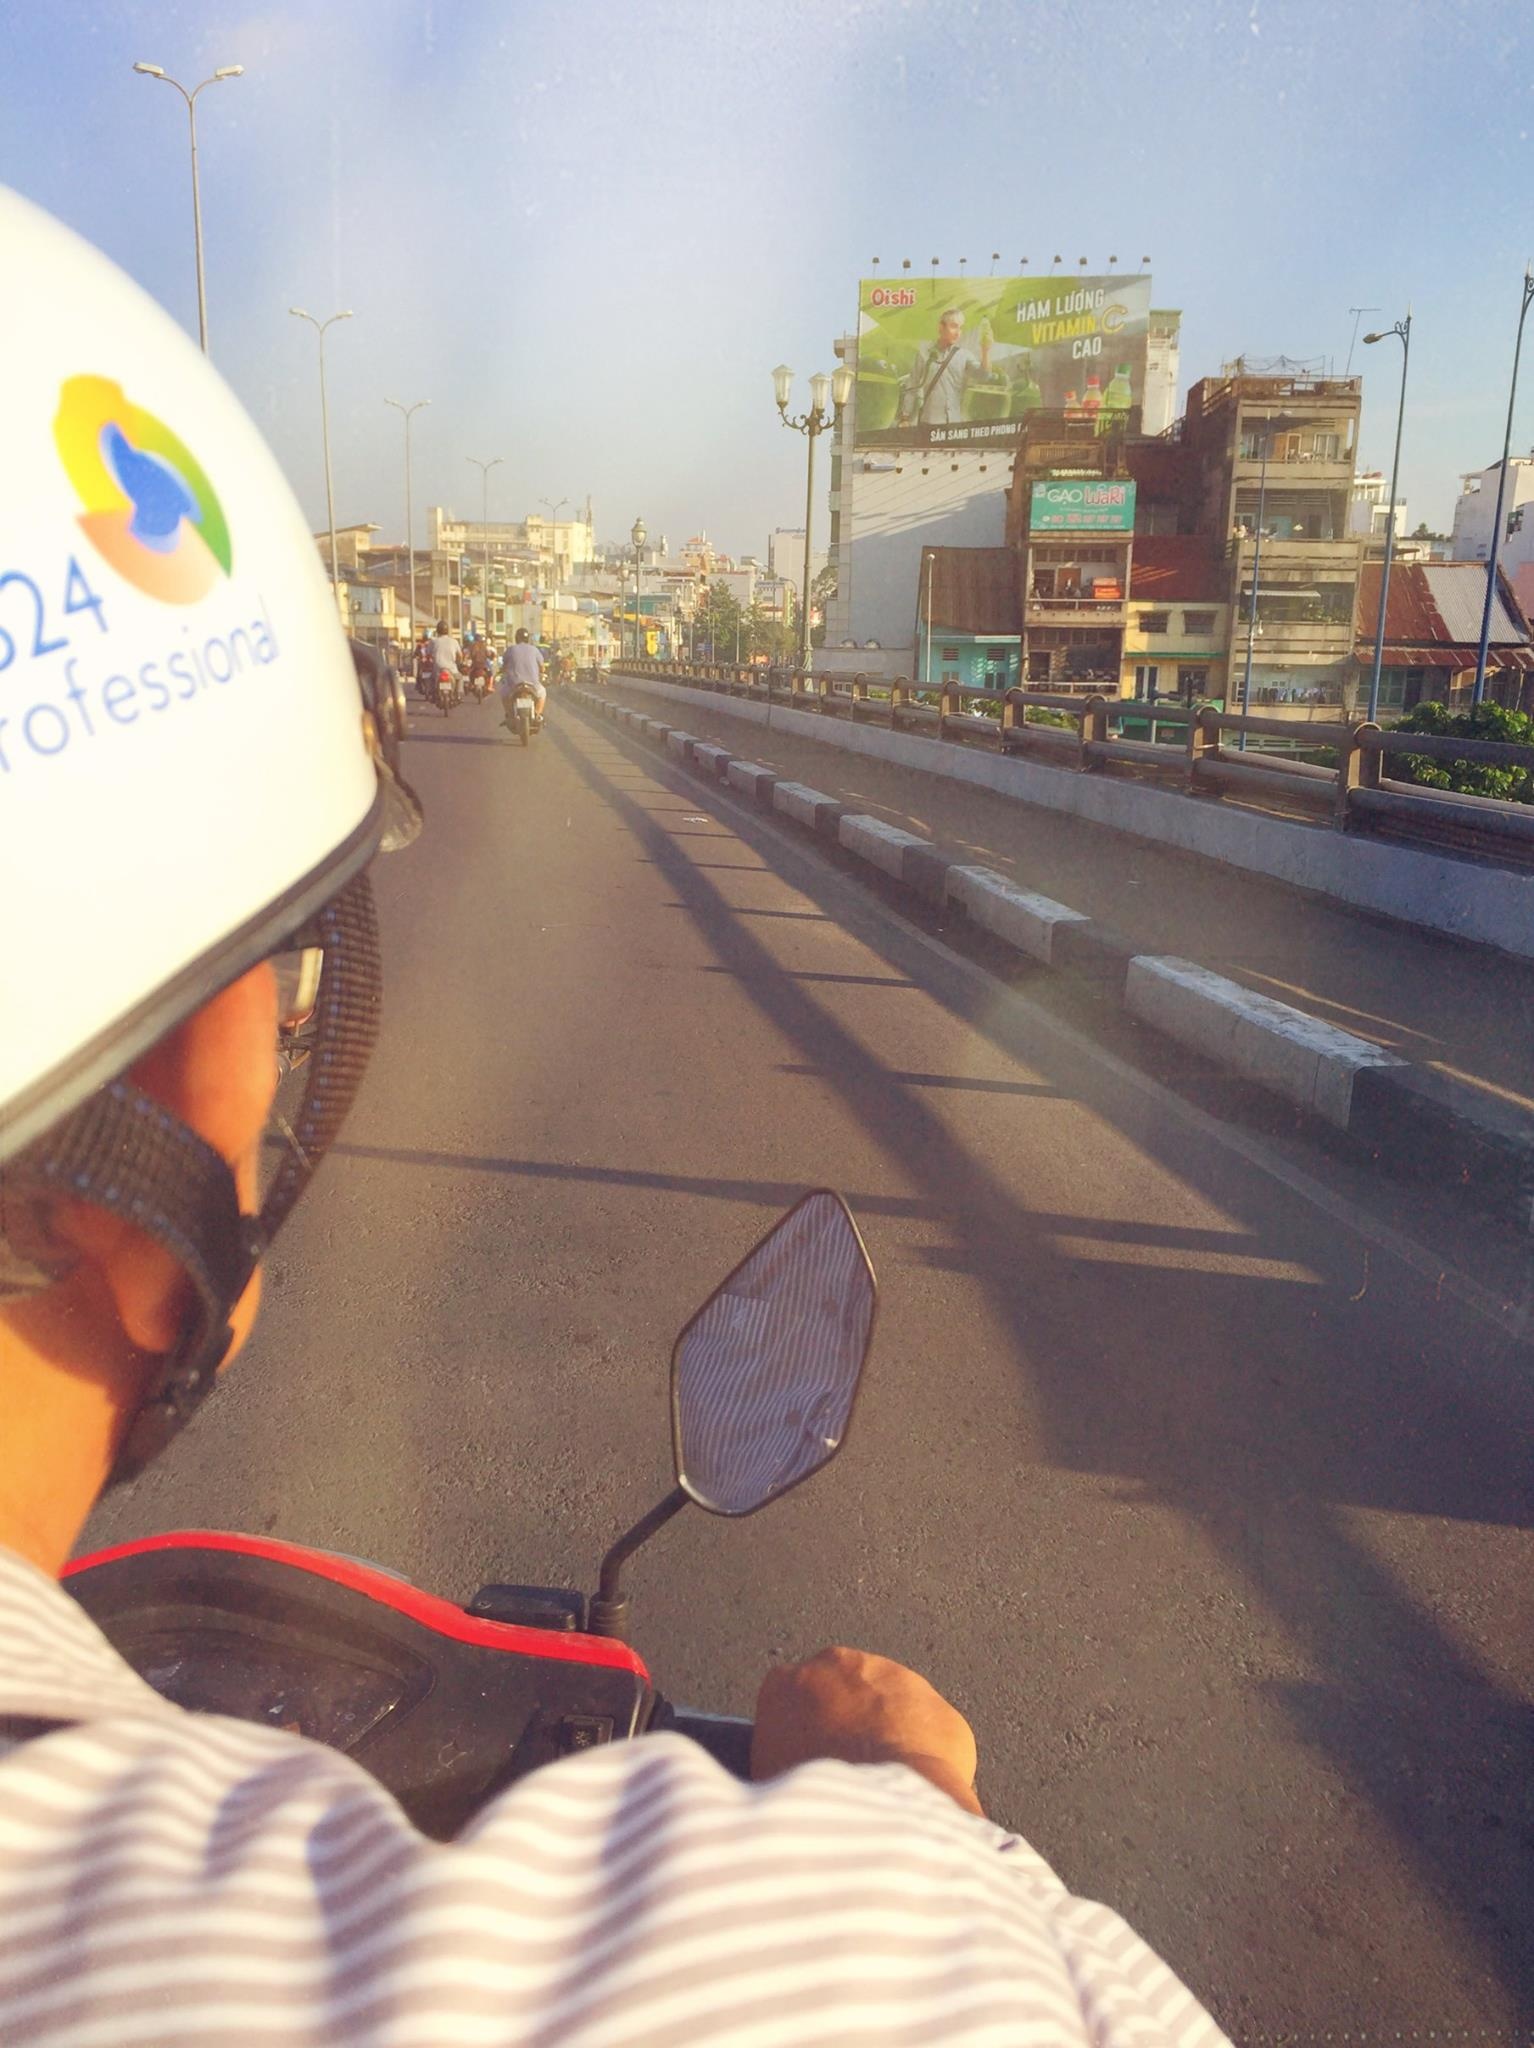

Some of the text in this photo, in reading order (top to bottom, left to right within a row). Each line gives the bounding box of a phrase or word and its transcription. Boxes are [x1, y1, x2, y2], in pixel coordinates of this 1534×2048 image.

[870, 287, 915, 307] Oishi
[1056, 288, 1105, 315] LƯỢNG
[1031, 304, 1129, 345] VITAMIN C
[1072, 336, 1102, 359] CAO
[970, 426, 990, 439] THEO
[1047, 488, 1083, 505] GẠO
